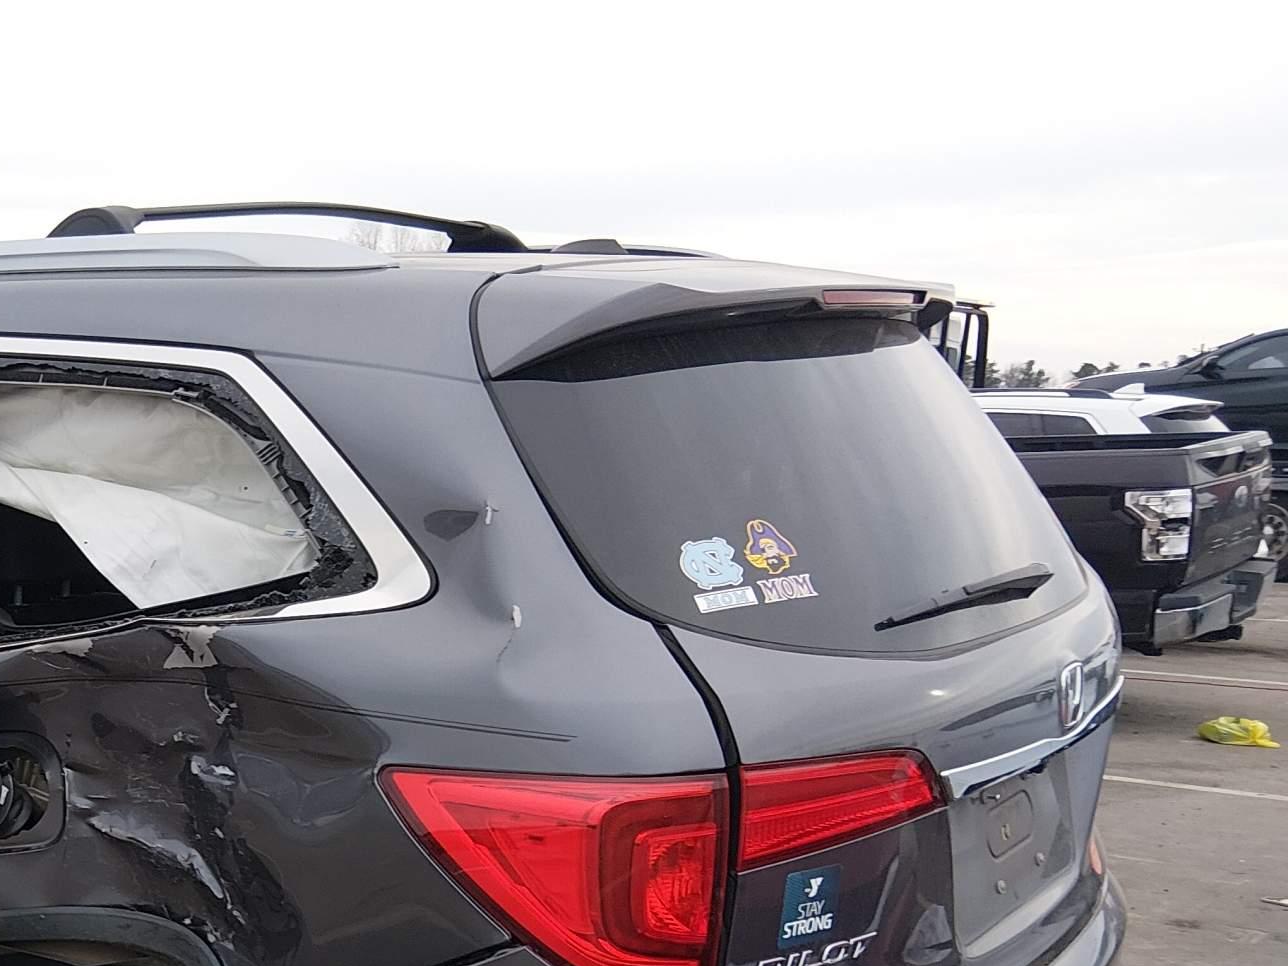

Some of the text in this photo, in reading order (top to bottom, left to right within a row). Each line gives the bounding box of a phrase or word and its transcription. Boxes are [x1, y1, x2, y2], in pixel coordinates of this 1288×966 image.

[757, 574, 818, 603] MOM
[797, 900, 825, 920] STAY
[782, 914, 833, 938] STRONG
